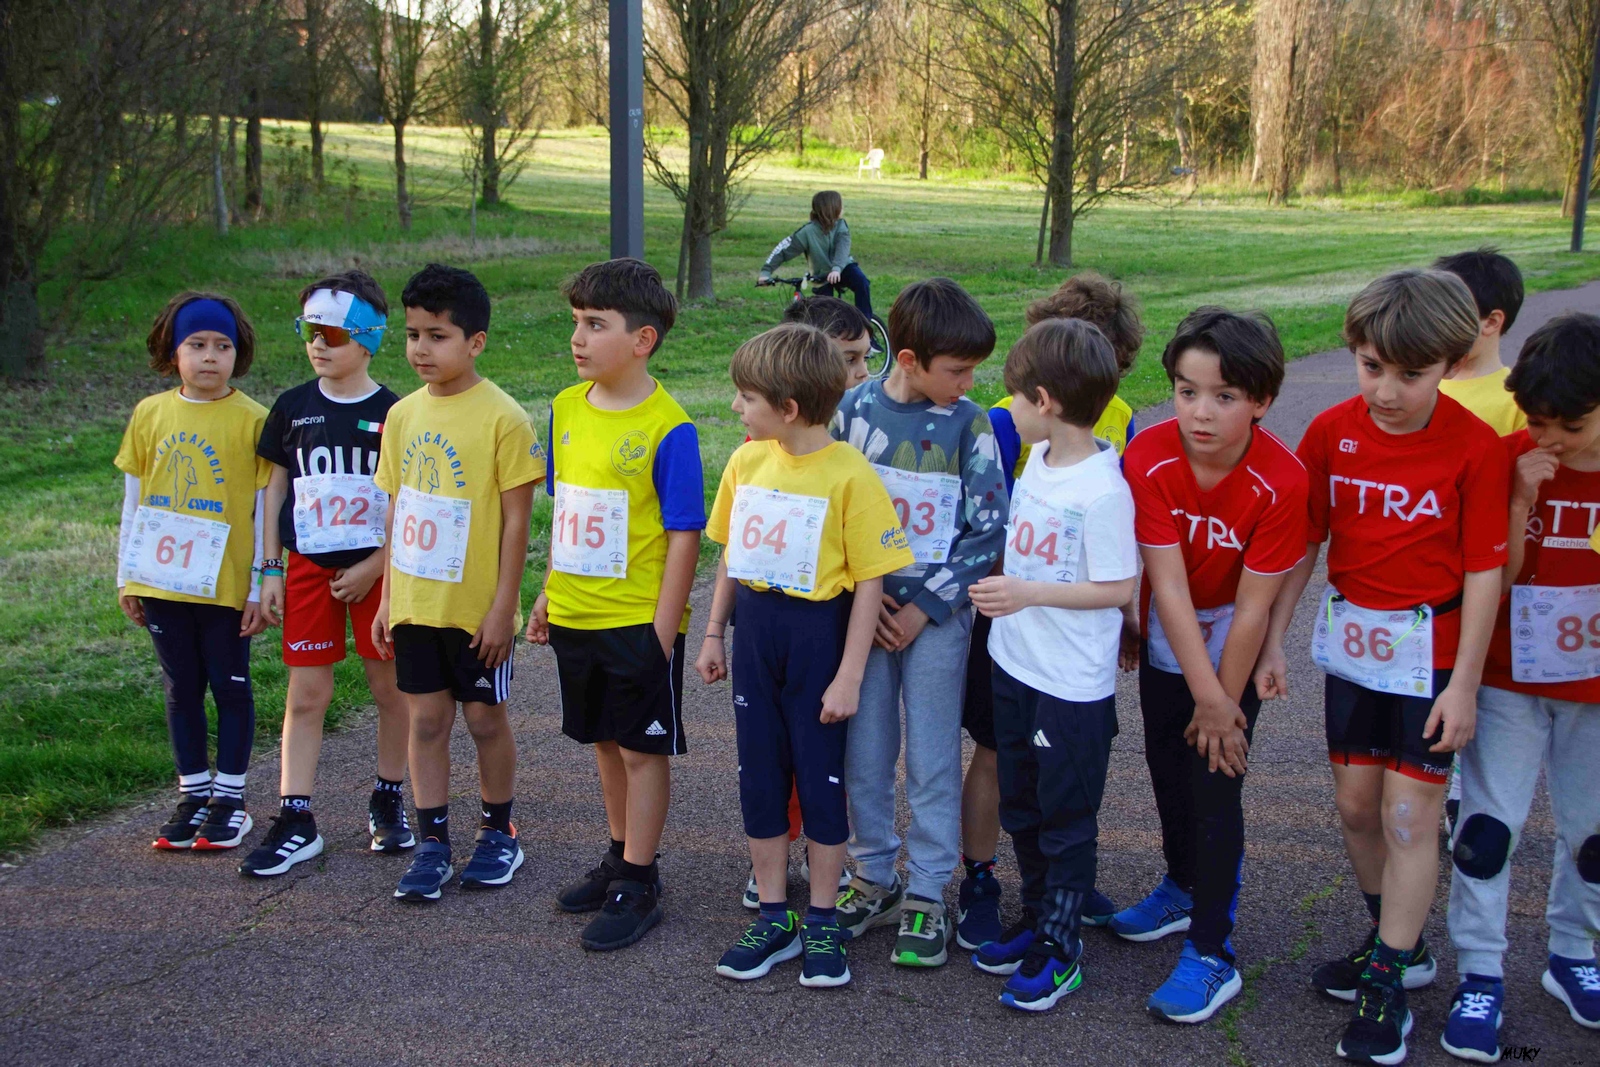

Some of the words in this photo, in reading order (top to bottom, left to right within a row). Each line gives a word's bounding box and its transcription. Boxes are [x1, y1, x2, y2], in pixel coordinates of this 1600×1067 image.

[309, 495, 370, 528] 122
[558, 510, 606, 549] 115
[892, 497, 936, 536] 03
[156, 535, 194, 569] 61
[403, 514, 438, 552] 60
[742, 514, 787, 555] 64
[1343, 621, 1394, 662] 86
